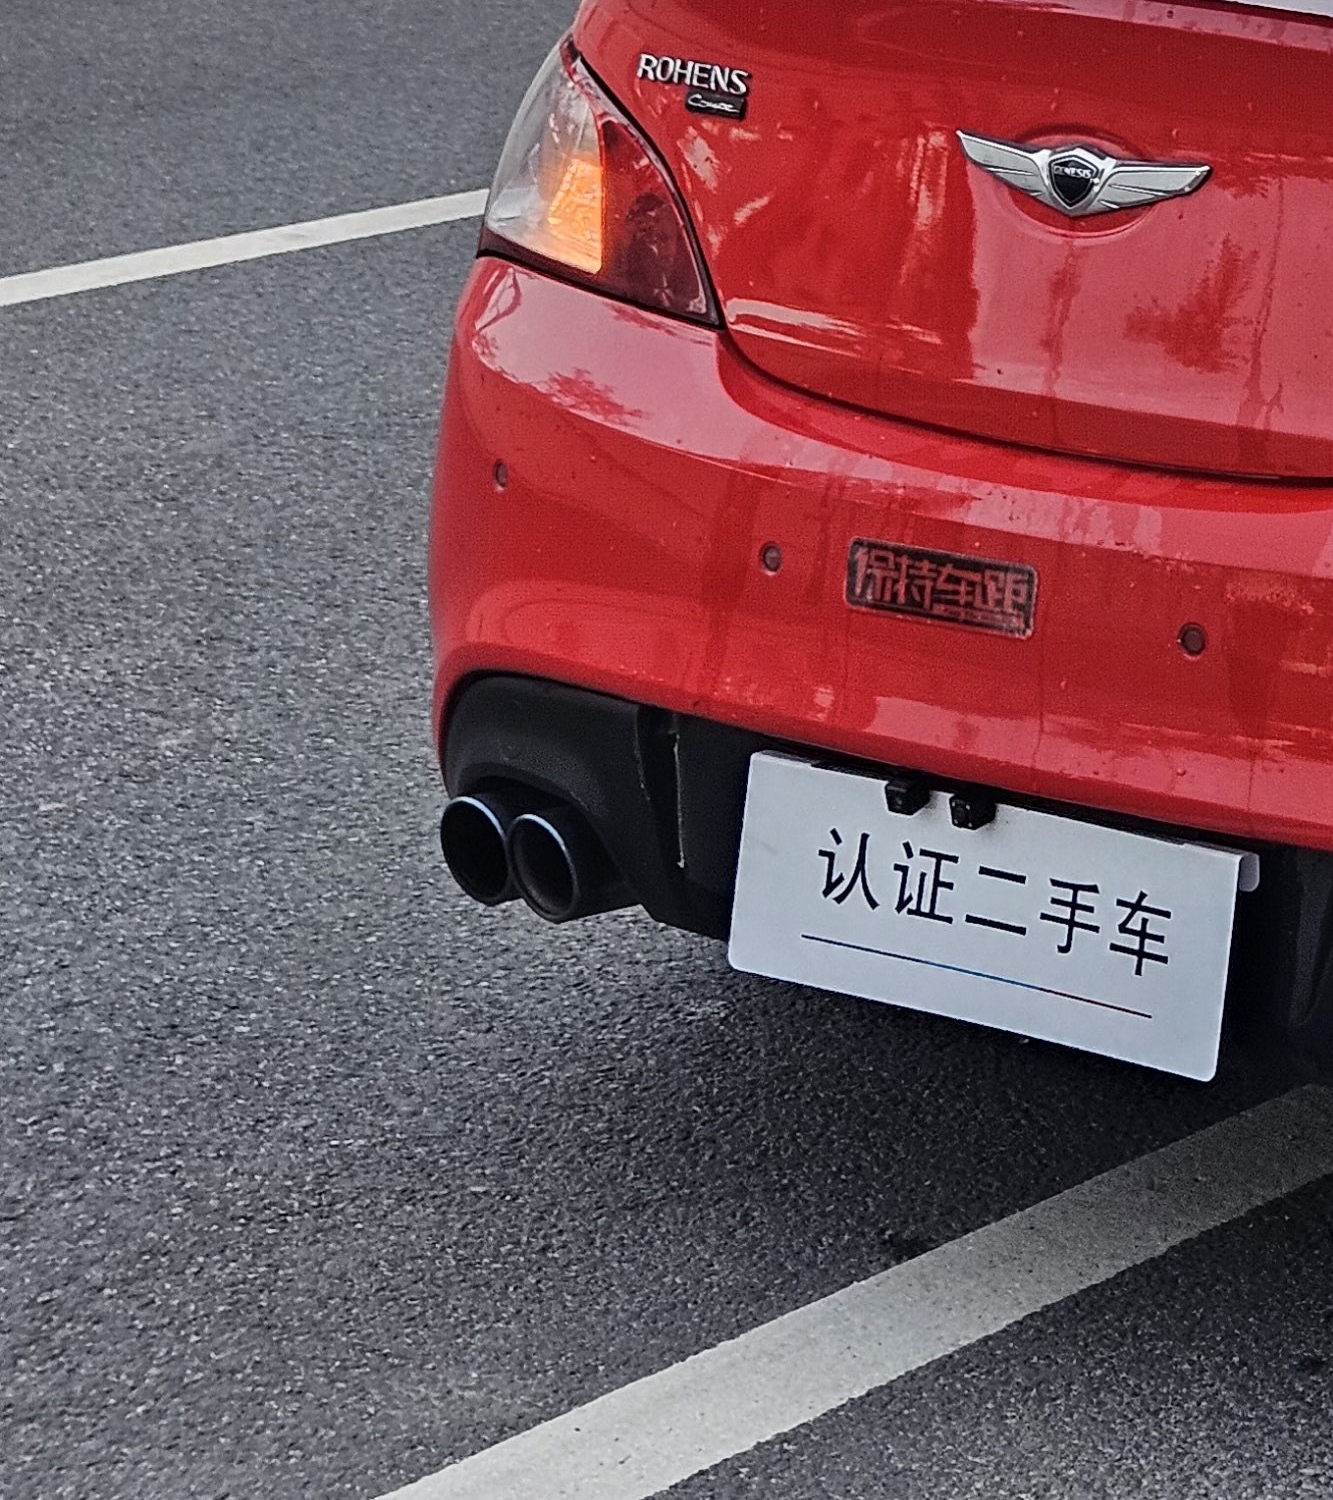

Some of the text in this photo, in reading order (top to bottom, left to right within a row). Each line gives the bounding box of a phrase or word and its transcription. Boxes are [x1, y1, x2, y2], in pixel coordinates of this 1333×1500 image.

[636, 53, 749, 95] ROHENS
[1053, 164, 1092, 179] GENESIS
[816, 827, 1173, 978] 认证二手车
